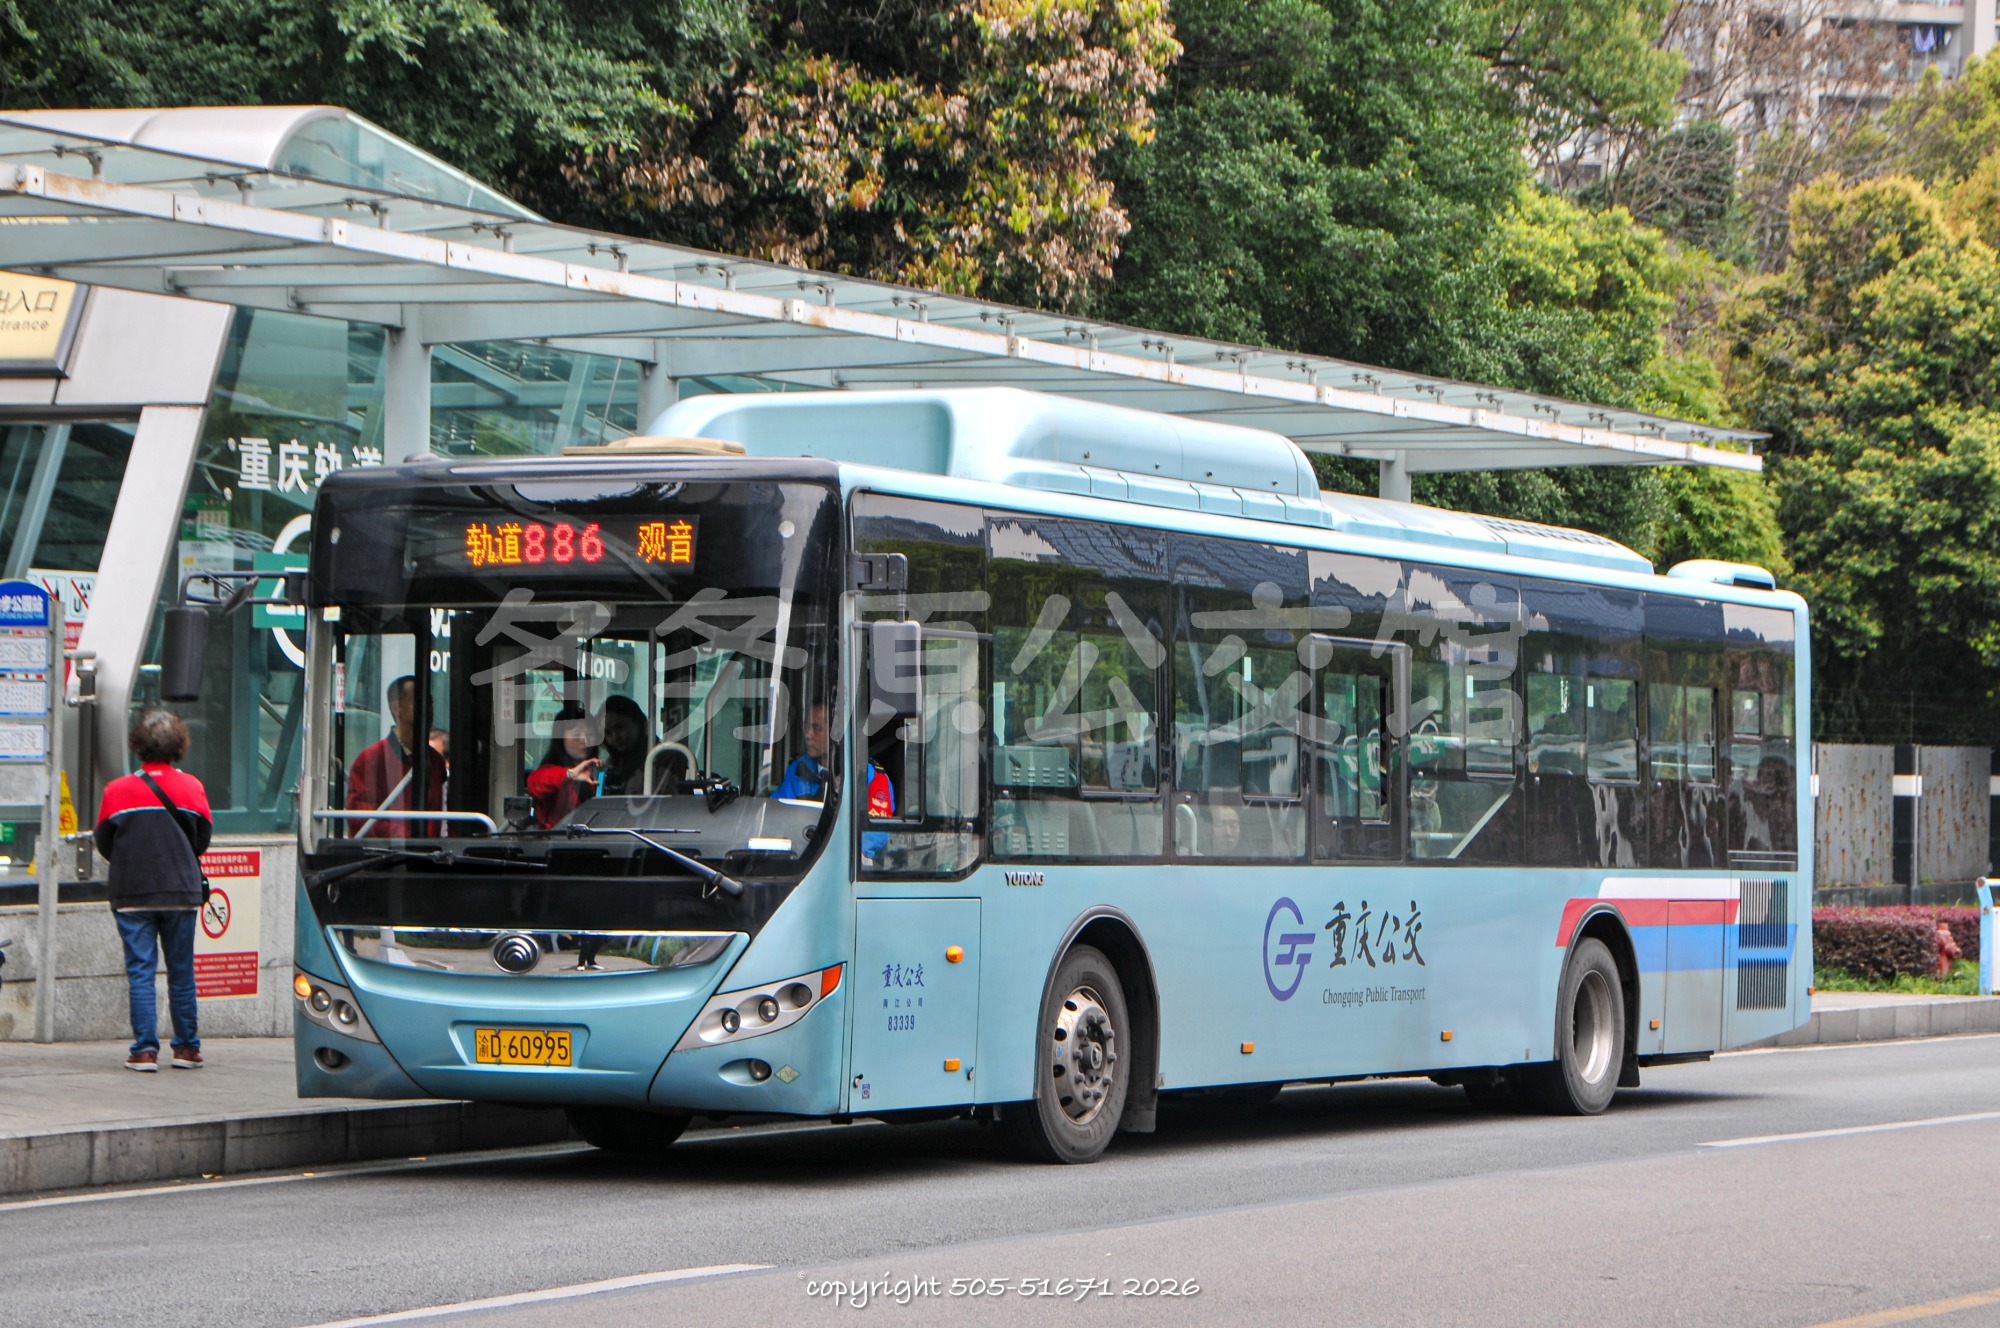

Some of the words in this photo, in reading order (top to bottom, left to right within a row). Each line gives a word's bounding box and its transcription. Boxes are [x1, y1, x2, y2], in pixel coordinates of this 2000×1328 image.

[637, 520, 693, 564] 观音
[1005, 871, 1045, 886] YUTONG
[1325, 900, 1426, 968] 重庆公交
[882, 963, 925, 988] 重庆公交
[1322, 988, 1364, 1008] Chongqing
[1365, 986, 1389, 1003] Public
[1390, 985, 1426, 1005] Transport
[887, 1014, 915, 1031] 83339
